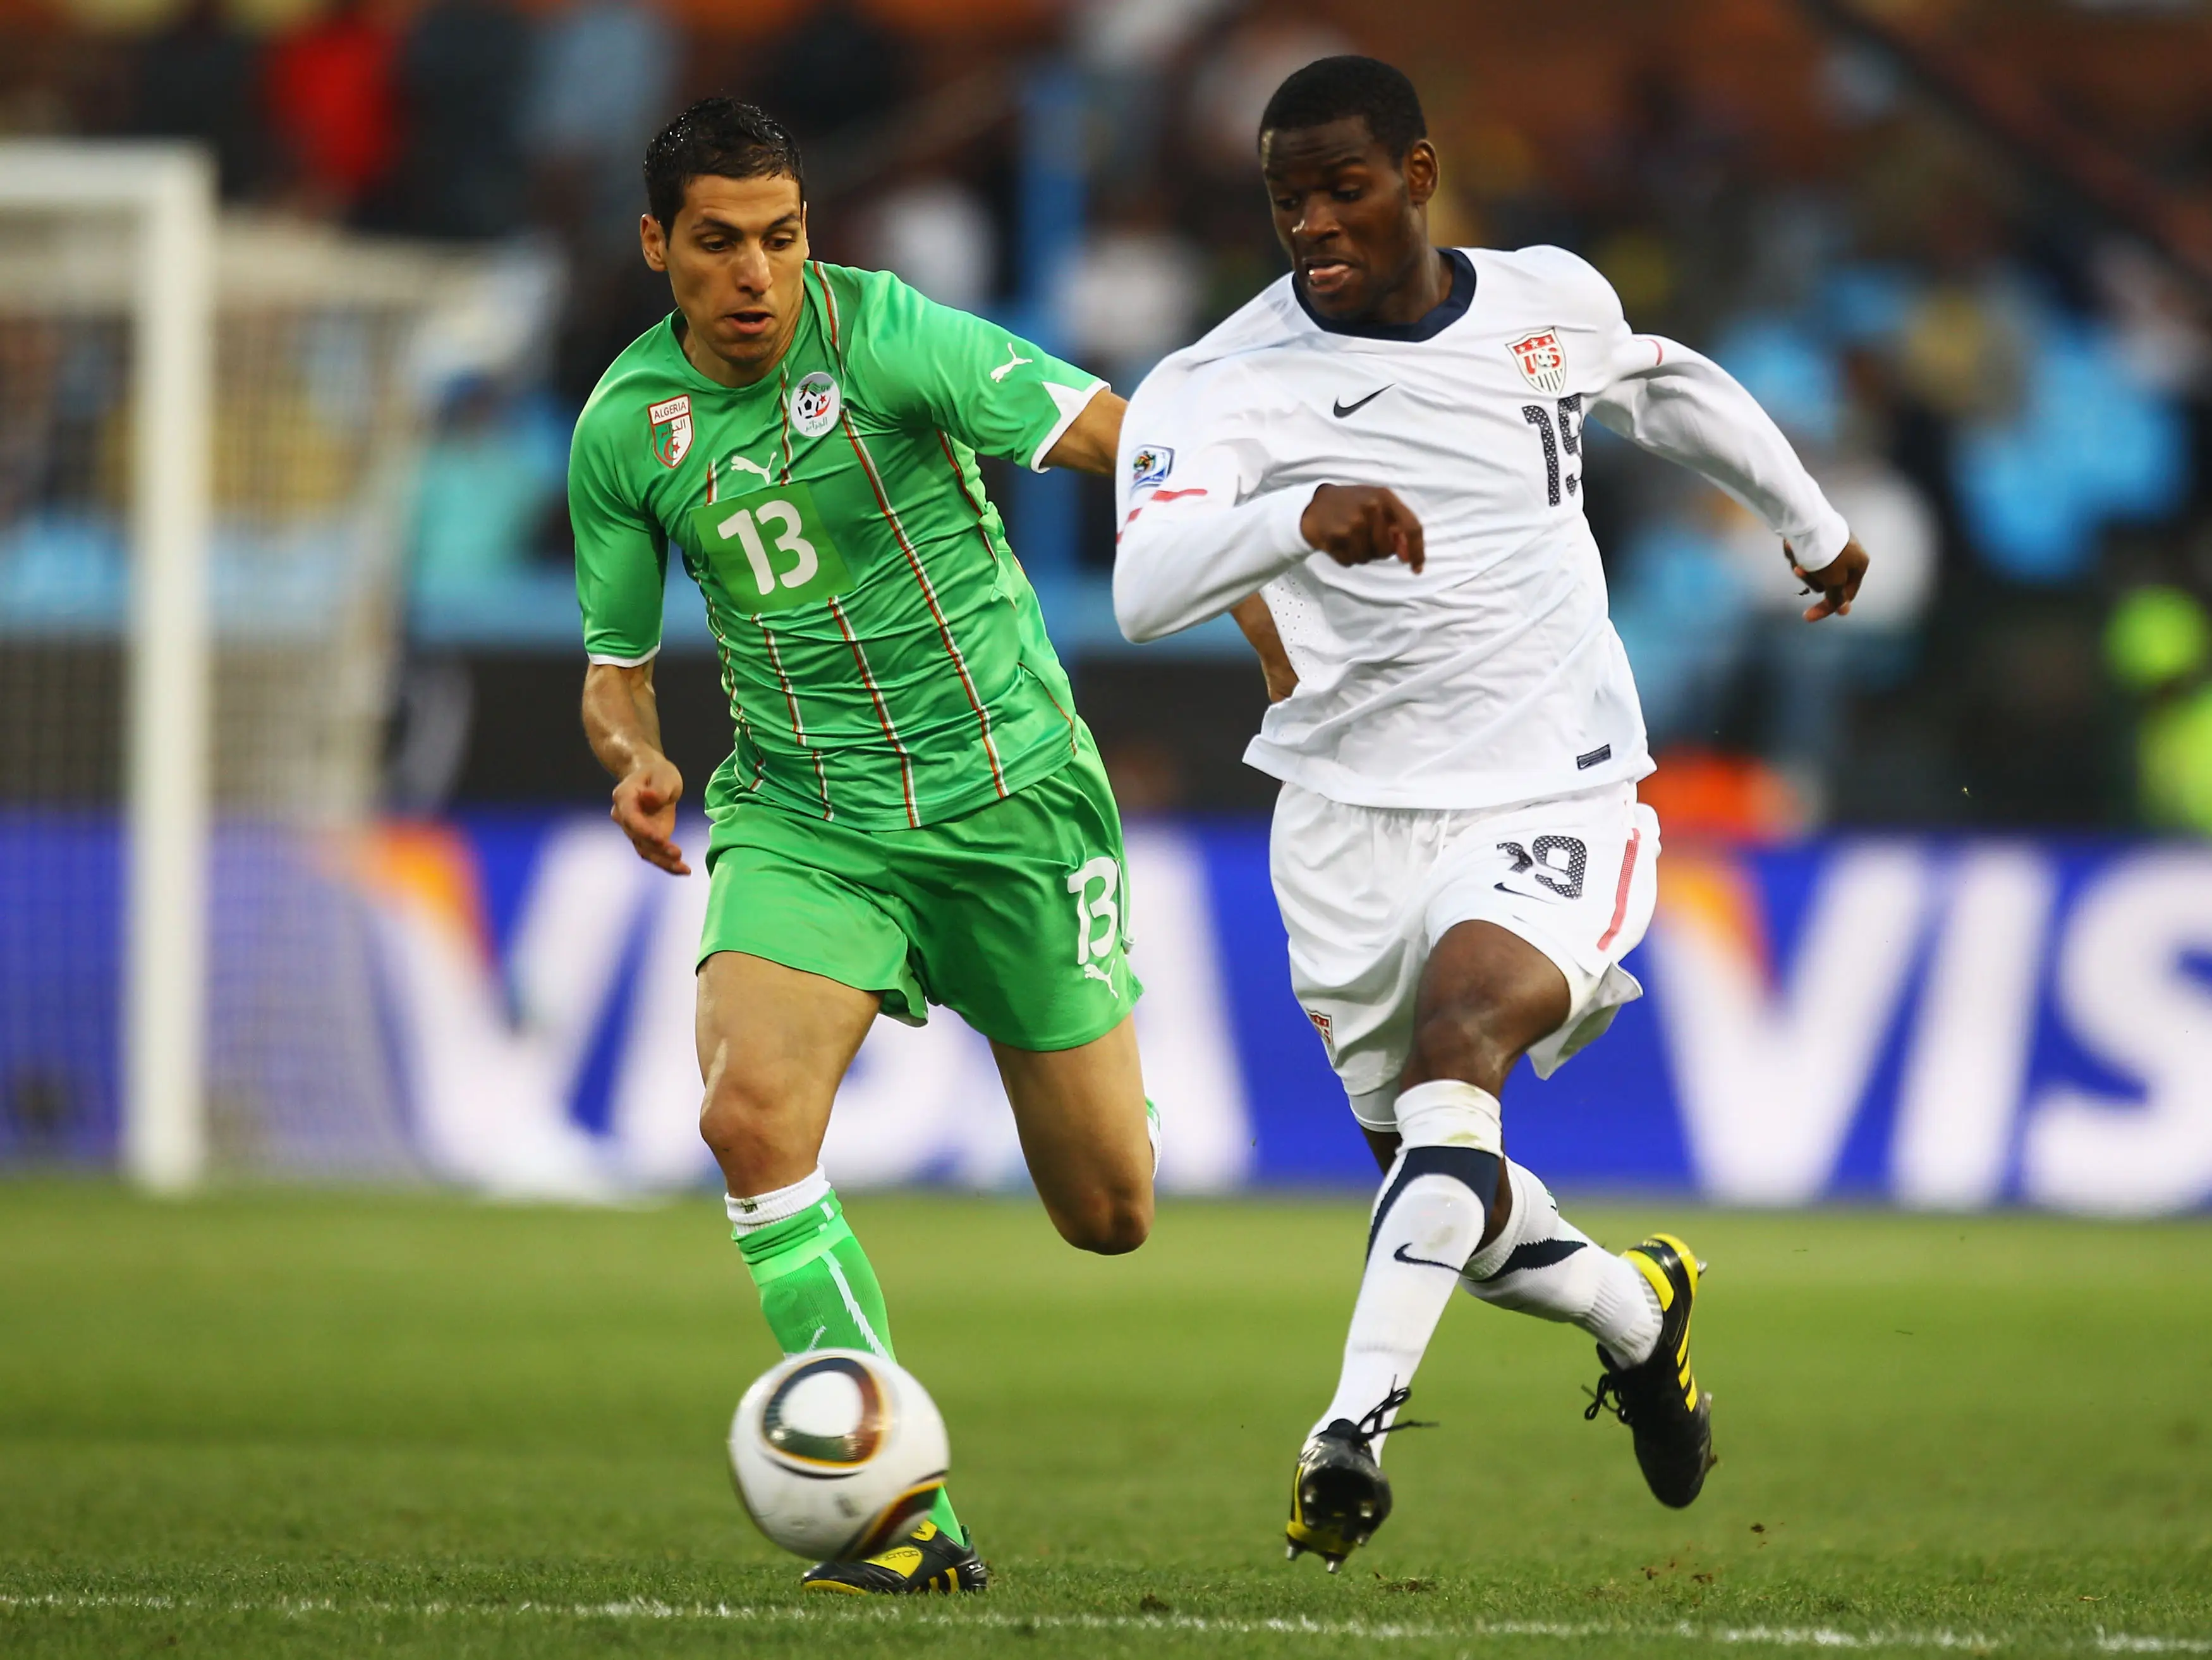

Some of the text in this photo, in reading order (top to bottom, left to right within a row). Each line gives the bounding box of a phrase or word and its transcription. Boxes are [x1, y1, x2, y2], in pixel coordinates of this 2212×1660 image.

[654, 401, 686, 420] ALGERIA
[717, 499, 818, 595] 13
[1067, 857, 1119, 965] 13
